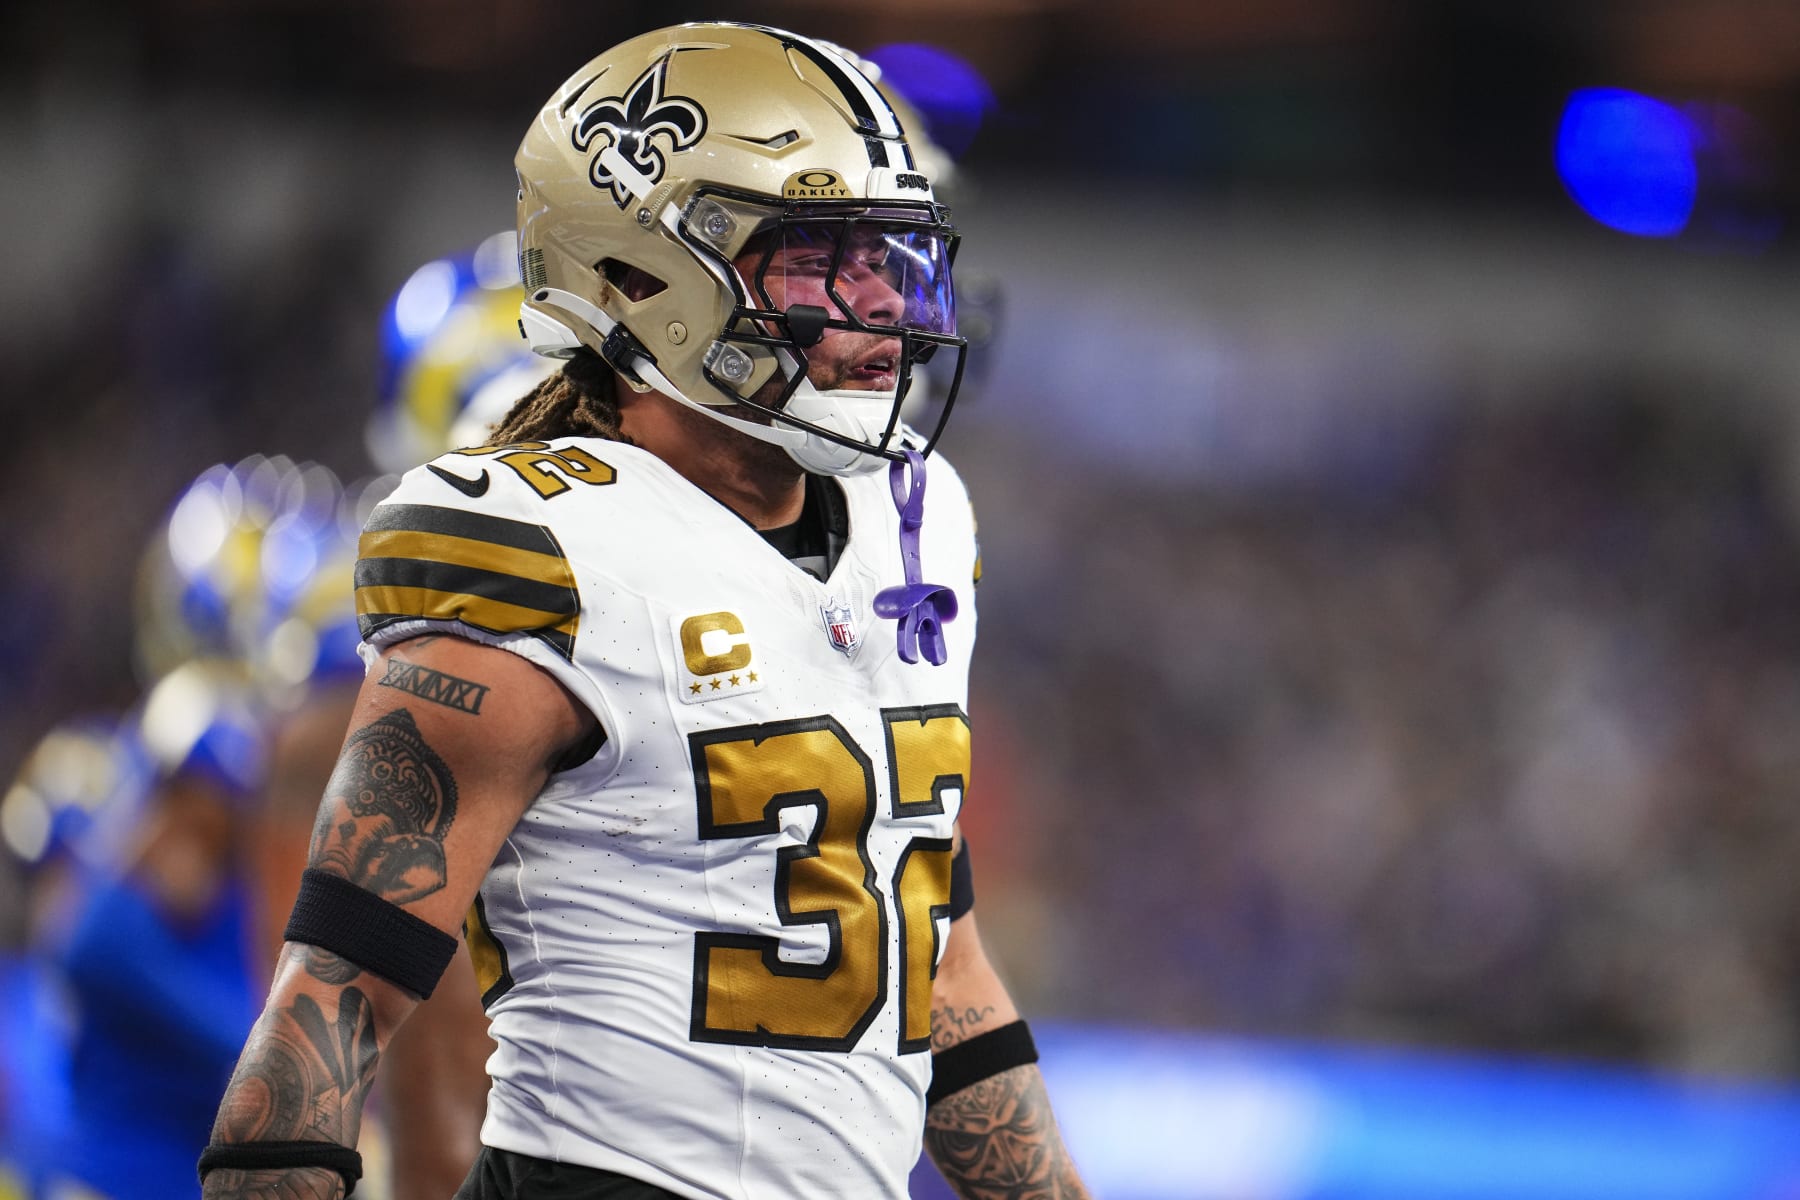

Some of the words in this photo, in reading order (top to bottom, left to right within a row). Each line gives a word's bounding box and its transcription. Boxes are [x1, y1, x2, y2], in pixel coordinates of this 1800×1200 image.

[680, 611, 752, 677] C
[831, 623, 856, 646] NFL
[688, 702, 972, 1056] 32
